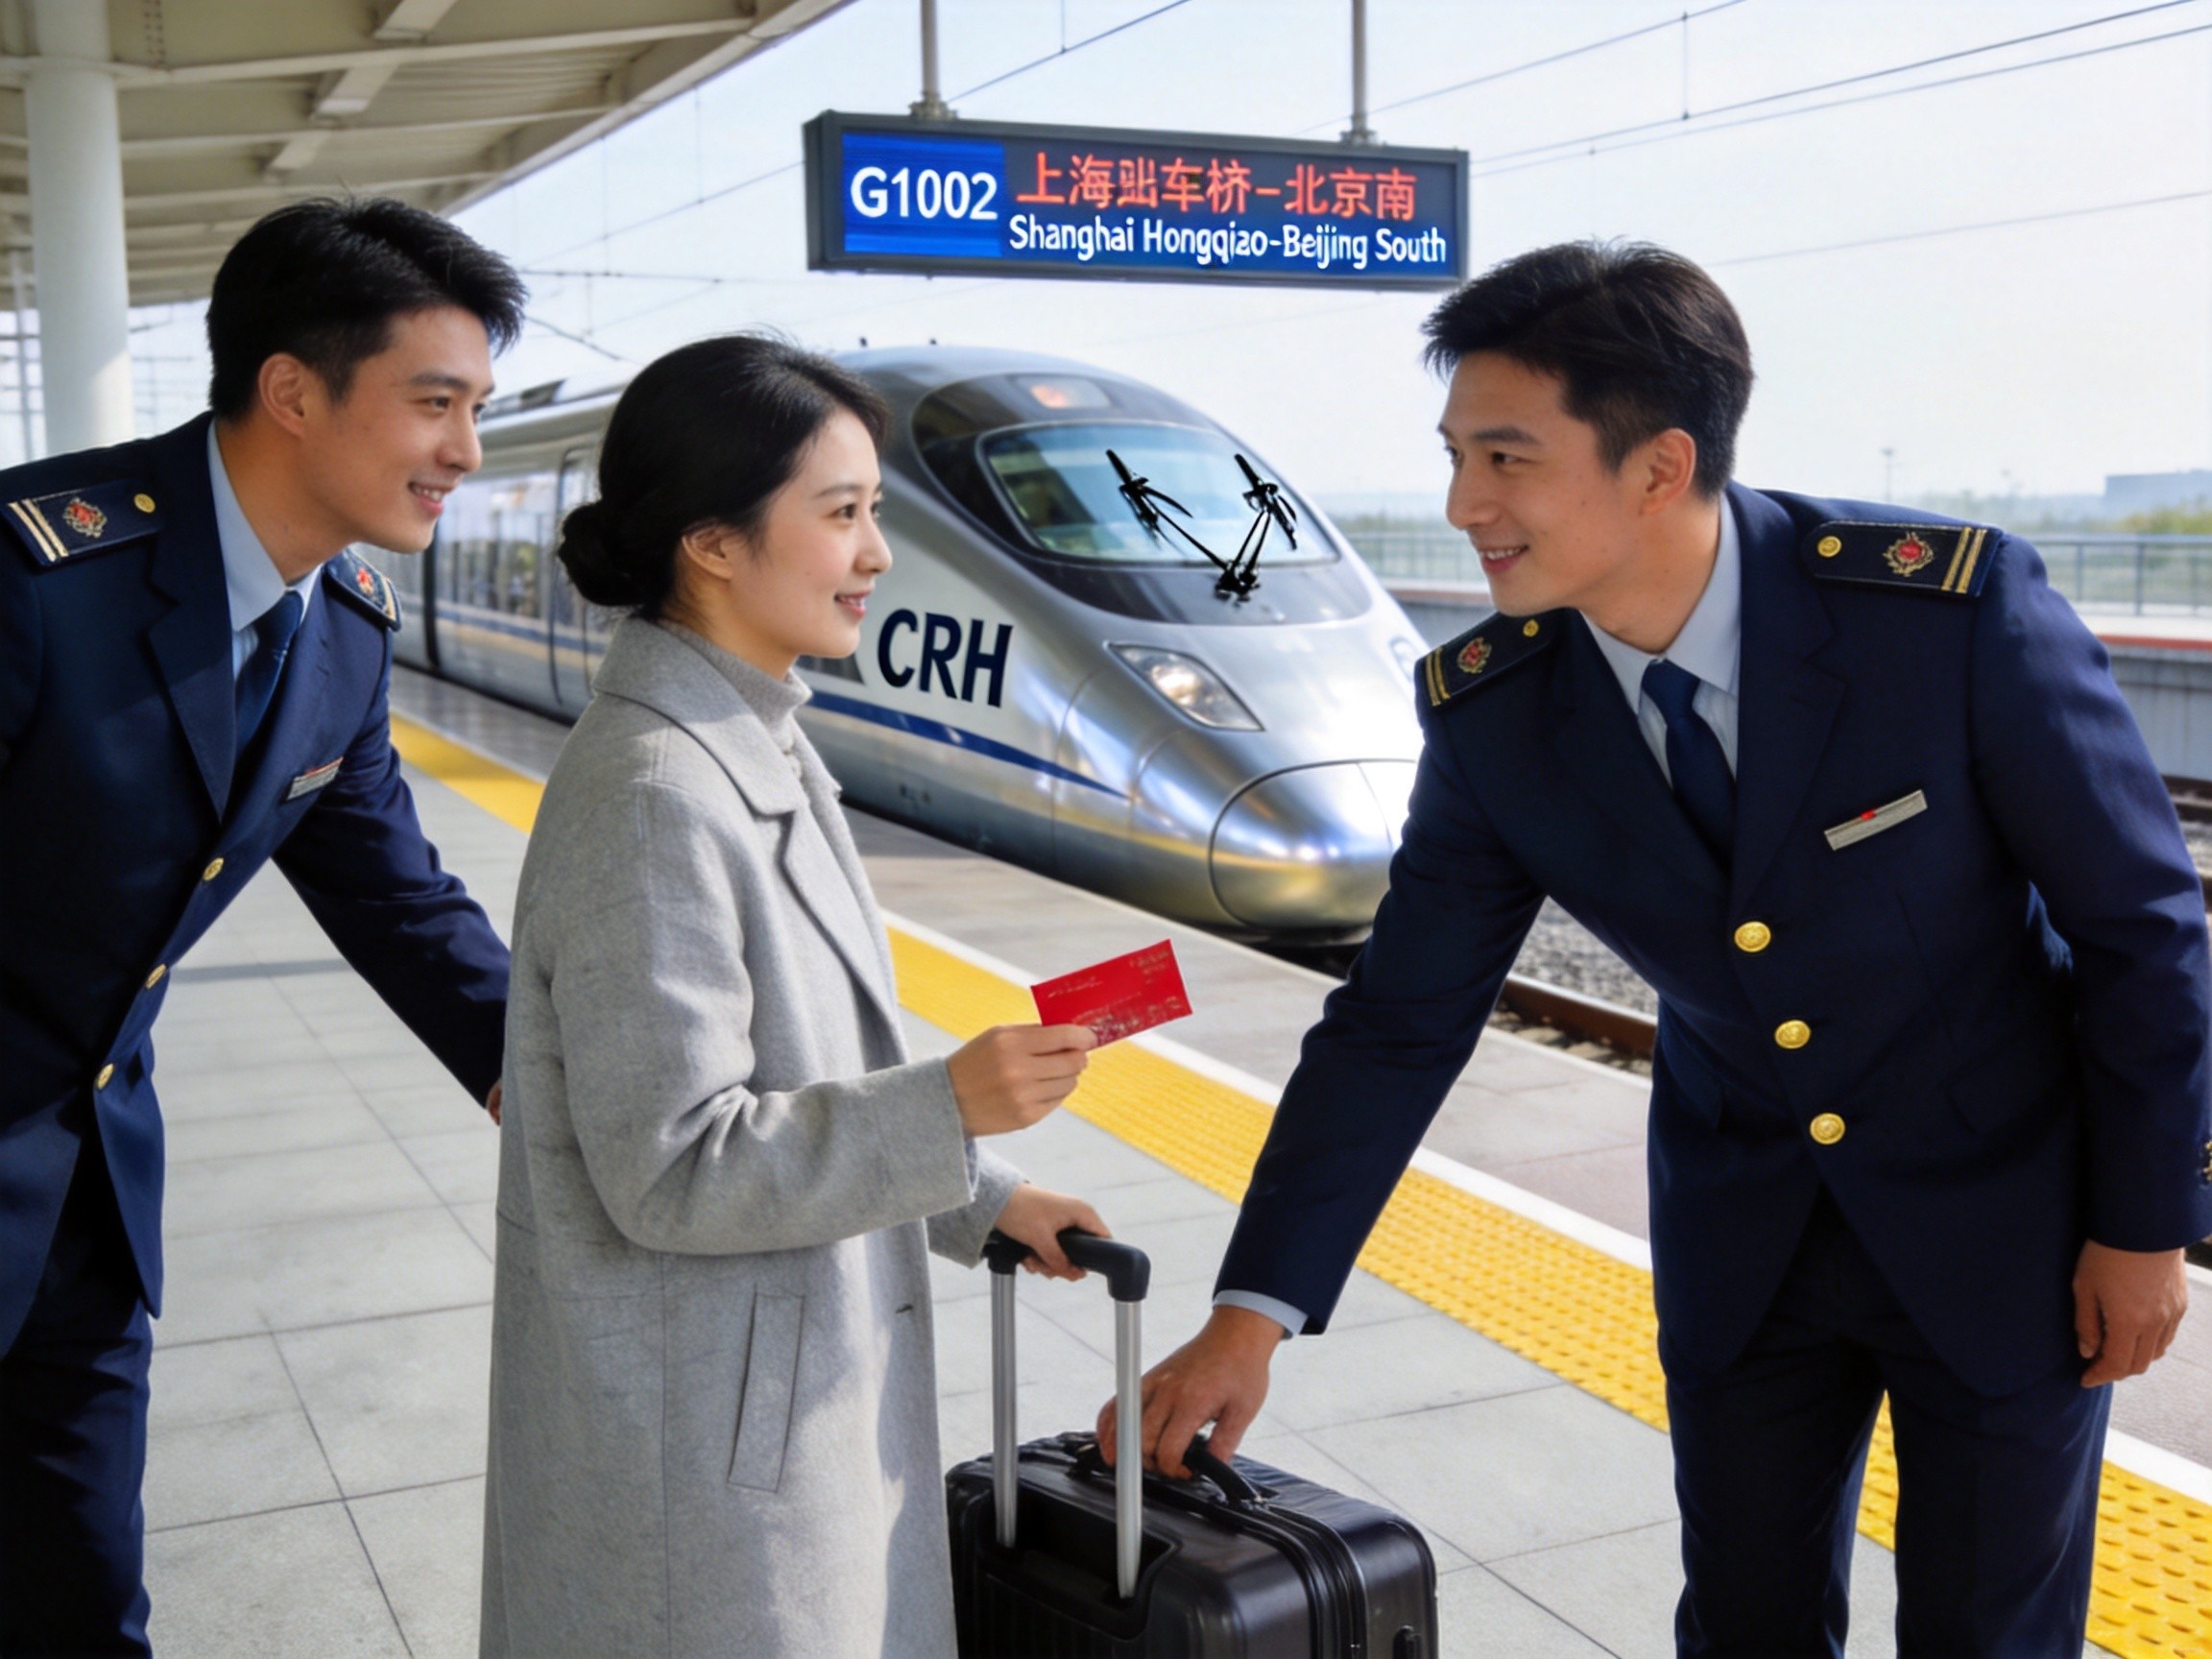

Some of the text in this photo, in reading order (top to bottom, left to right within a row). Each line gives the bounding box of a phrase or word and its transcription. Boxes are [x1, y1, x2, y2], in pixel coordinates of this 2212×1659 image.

[851, 166, 998, 220] G1002
[1010, 213, 1134, 261] Shanghai
[1375, 227, 1446, 263] South
[878, 609, 1014, 708] CRH
